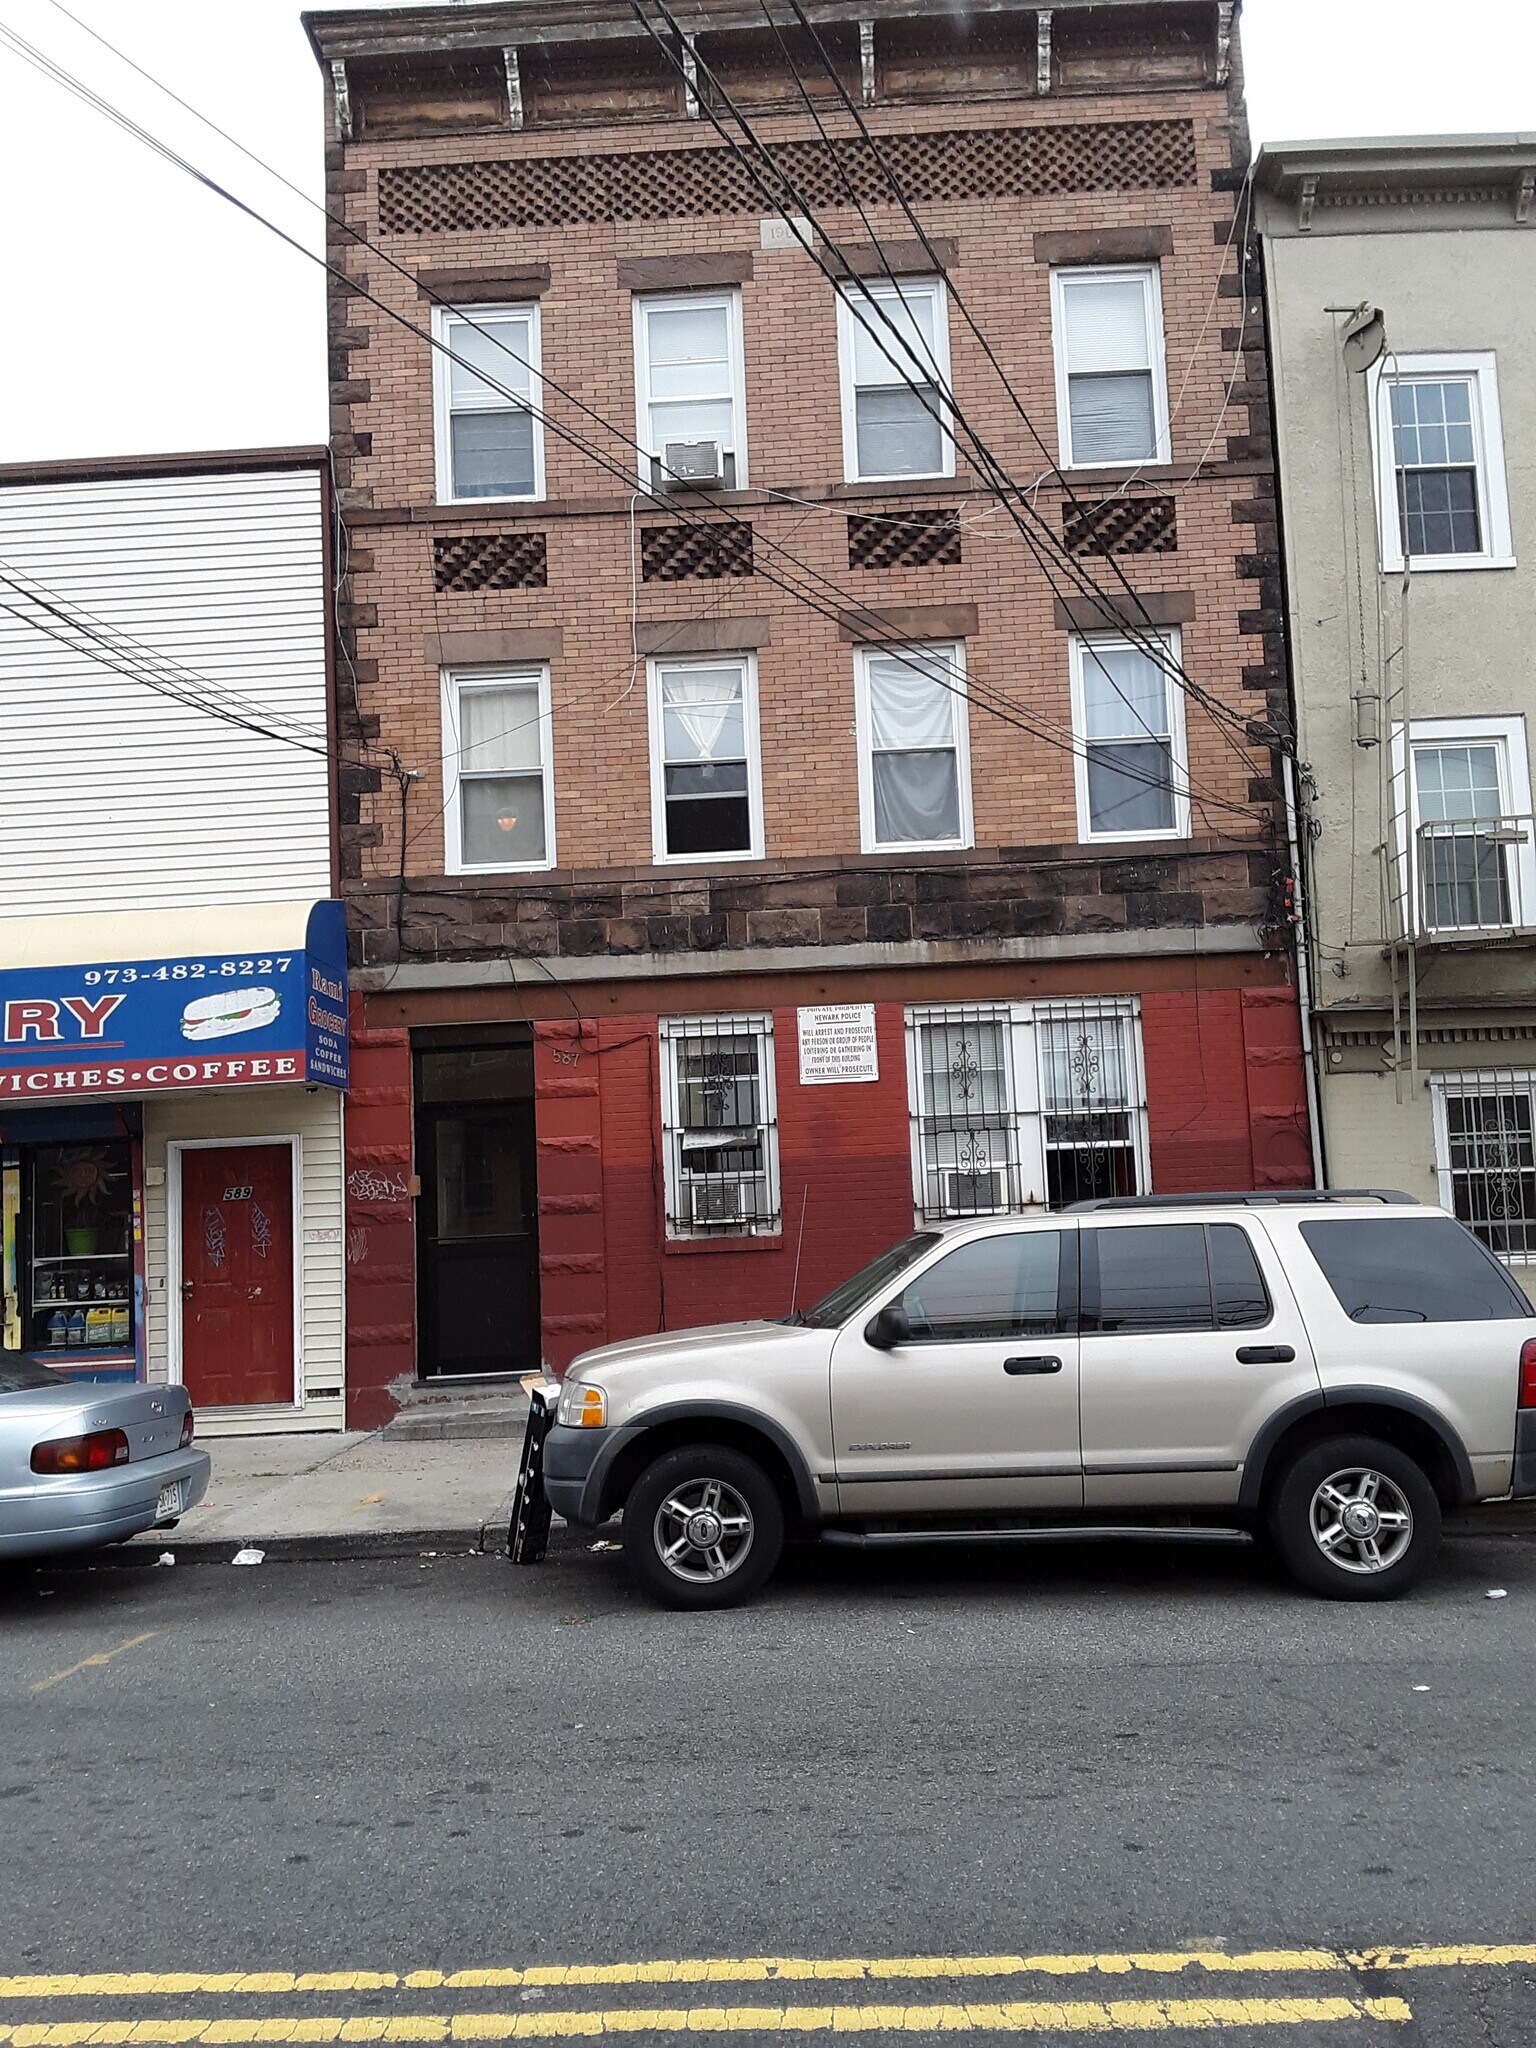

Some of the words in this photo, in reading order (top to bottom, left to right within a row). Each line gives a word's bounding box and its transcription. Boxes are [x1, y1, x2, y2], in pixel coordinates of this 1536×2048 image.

[84, 957, 292, 986] 973-482-8227
[311, 967, 344, 1003] Rami
[815, 1013, 839, 1021] NEWARK
[841, 1012, 861, 1020] POLICE
[802, 1029, 814, 1037] WILL
[815, 1028, 833, 1036] ARREST
[834, 1027, 844, 1035] AND
[845, 1026, 873, 1035] PROSECUTE
[318, 1035, 338, 1050] SODA
[811, 1037, 828, 1046] PERSON
[858, 1035, 874, 1043] PEOPLE
[315, 1047, 342, 1064] COFFEE
[804, 1046, 829, 1055] LOITERING
[830, 1046, 837, 1054] OR
[838, 1045, 865, 1053] GATHERING
[553, 1049, 579, 1068] 587
[310, 1060, 347, 1079] SANDWICHES
[805, 1066, 826, 1075] OWNER
[827, 1066, 840, 1074] WILL
[841, 1065, 873, 1073] PROSECUTE
[224, 1186, 251, 1200] 589
[848, 1441, 912, 1452] EXPLORER
